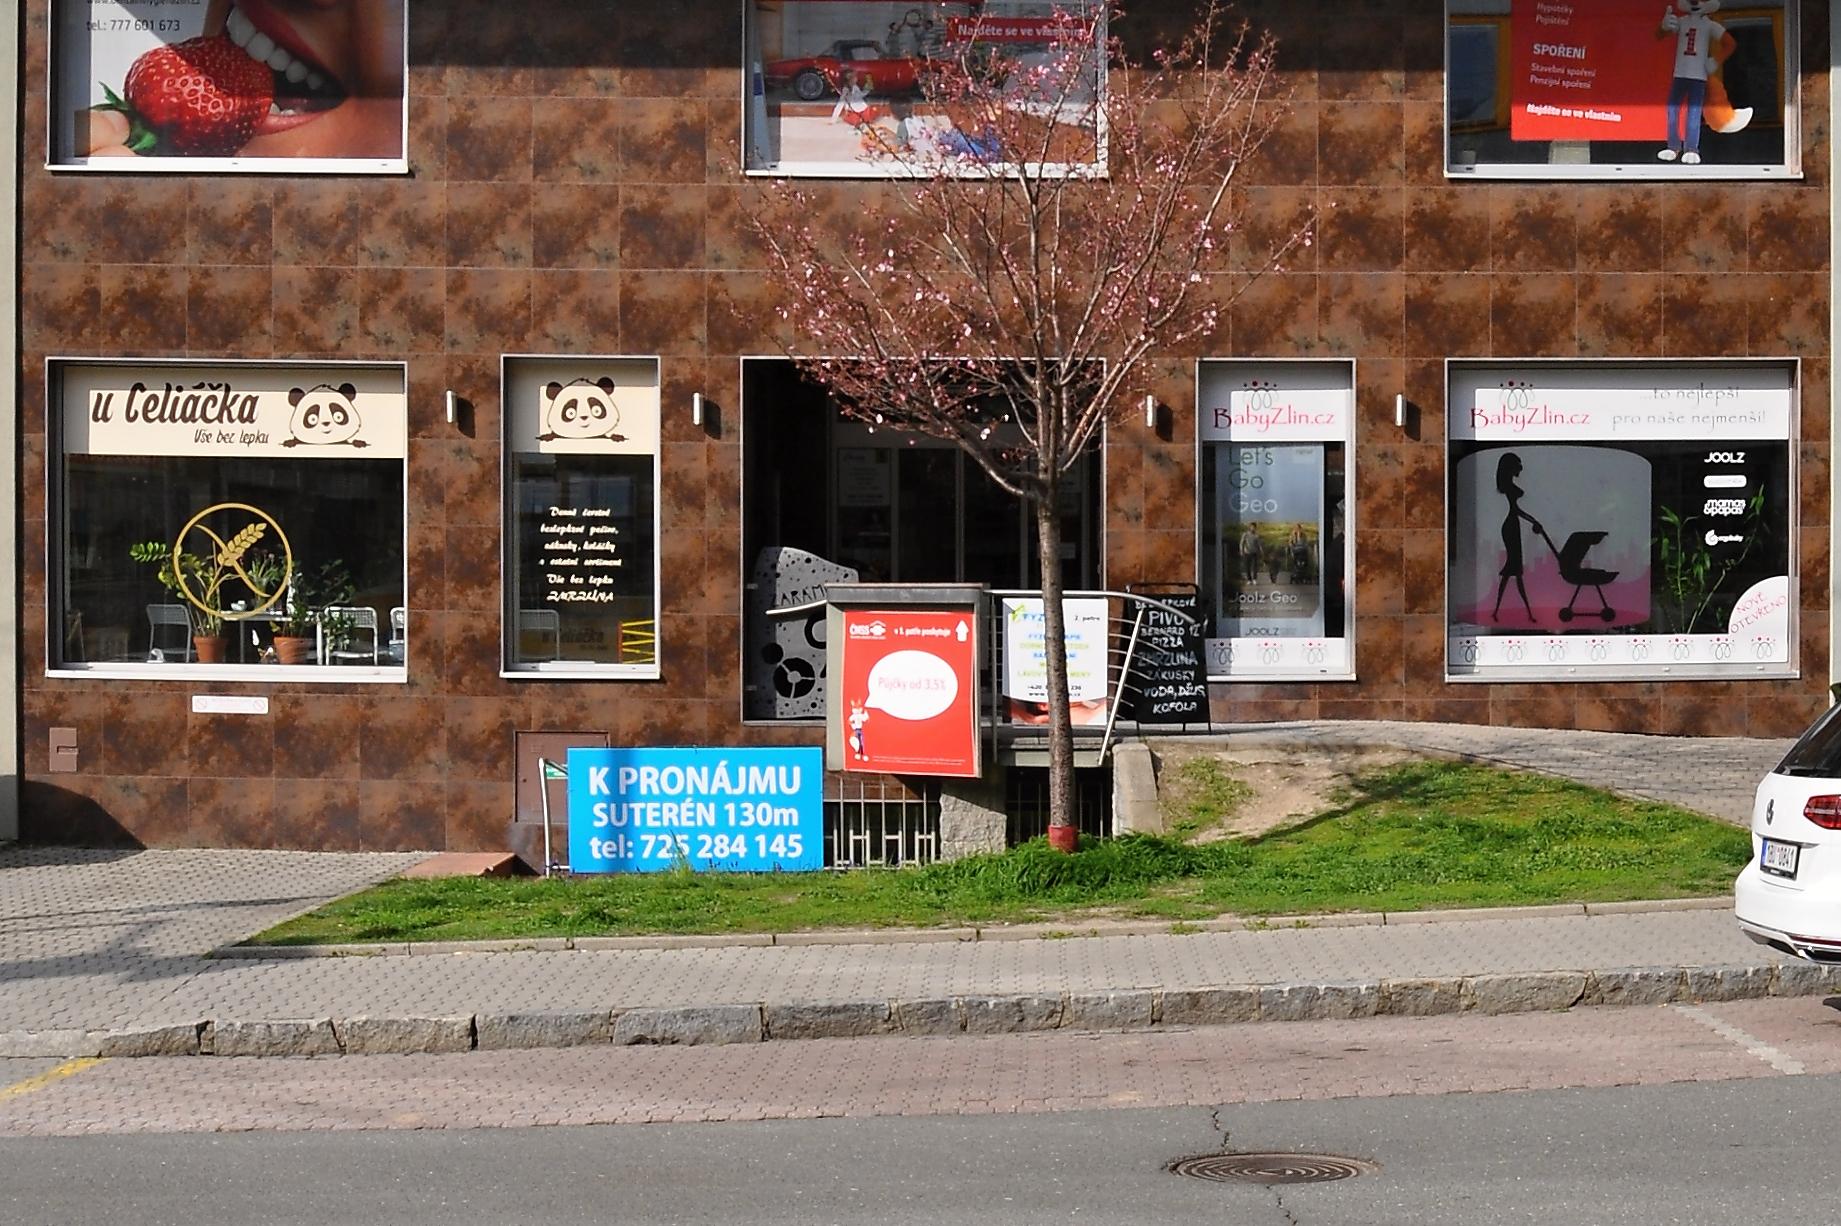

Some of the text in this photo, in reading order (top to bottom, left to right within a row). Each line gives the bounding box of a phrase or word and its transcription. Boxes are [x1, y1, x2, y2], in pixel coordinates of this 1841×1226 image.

[111, 20, 130, 31] 777
[134, 20, 155, 31] 601
[159, 20, 181, 31] 673
[1533, 43, 1587, 60] SPOŘENÍ
[92, 382, 260, 425] u Celiáčka
[1676, 382, 1739, 409] nejlepší
[1213, 404, 1335, 433] BabyZlin.cz
[1470, 405, 1591, 433] BabyZlin.cz
[1612, 410, 1766, 432] pro naše nejmenší!
[194, 428, 270, 448] Vše bez lepku
[1704, 452, 1746, 463] JOOLZ
[1229, 468, 1265, 489] Go
[1230, 491, 1279, 513] Geo
[1229, 590, 1298, 603] Joolz Geo
[1246, 626, 1280, 636] JOOLZ
[909, 678, 922, 689] od
[1152, 702, 1197, 714] KOFOLA
[588, 760, 802, 796] K PRONÁJMU
[592, 797, 799, 827] SUTERÉN 130m
[589, 833, 803, 859] tel: 725 284 145
